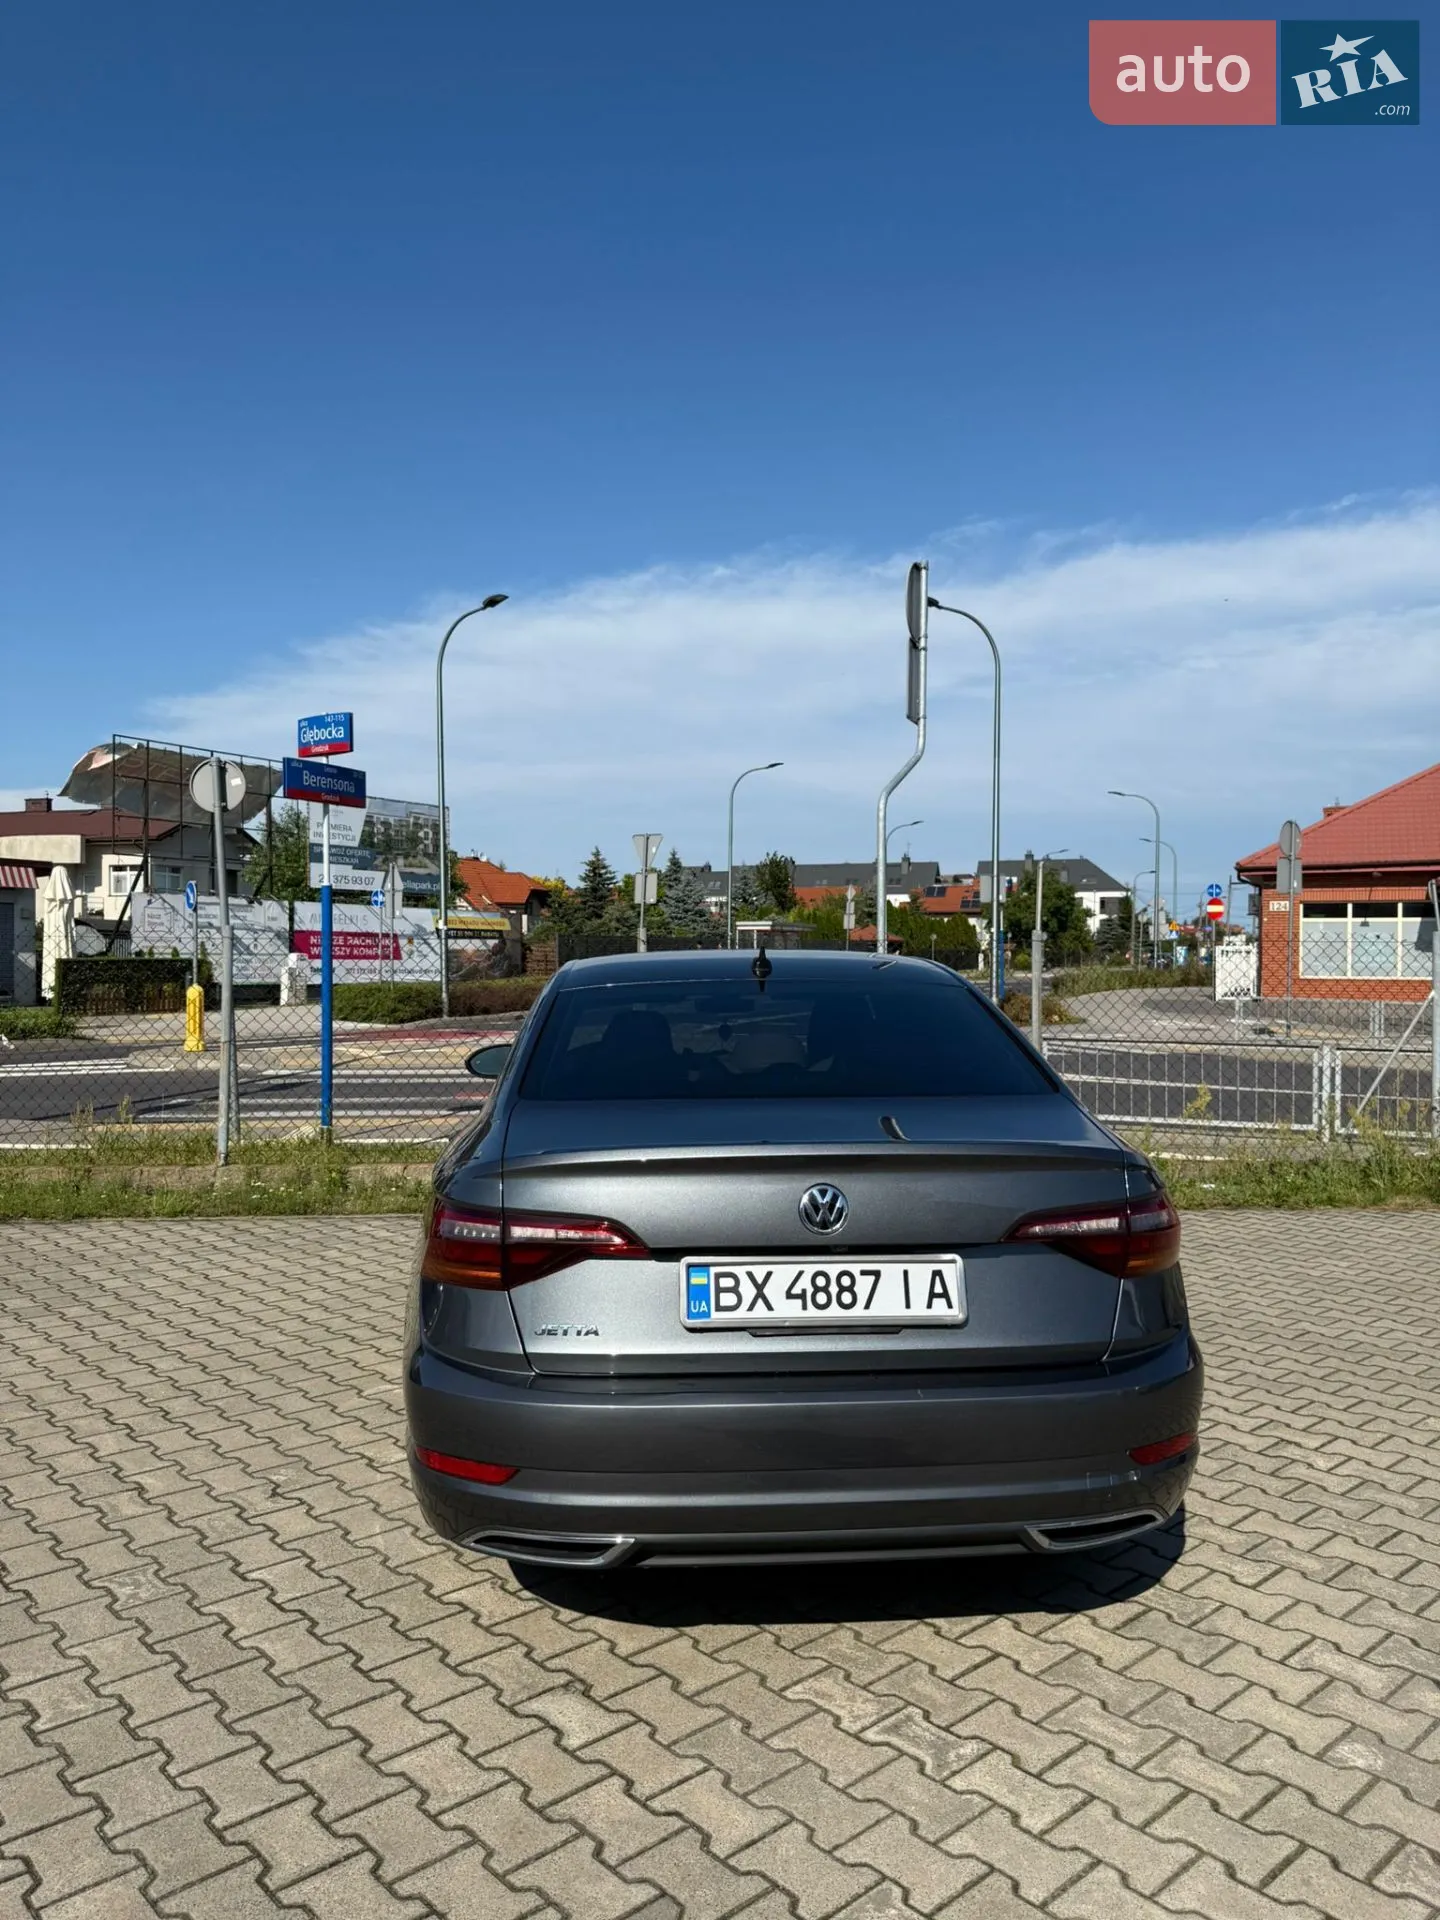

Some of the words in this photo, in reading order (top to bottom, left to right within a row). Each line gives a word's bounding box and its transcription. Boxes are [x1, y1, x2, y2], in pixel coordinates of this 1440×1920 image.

[300, 723, 345, 745] Głębocka
[302, 770, 355, 793] Berensona
[332, 875, 350, 884] 375
[351, 876, 363, 885] 93
[364, 877, 376, 886] 07
[1271, 902, 1288, 911] 124
[713, 1270, 775, 1313] BX
[785, 1269, 882, 1311] 4887
[903, 1269, 954, 1310] IA
[691, 1301, 709, 1313] UA
[534, 1324, 600, 1337] JETTA
